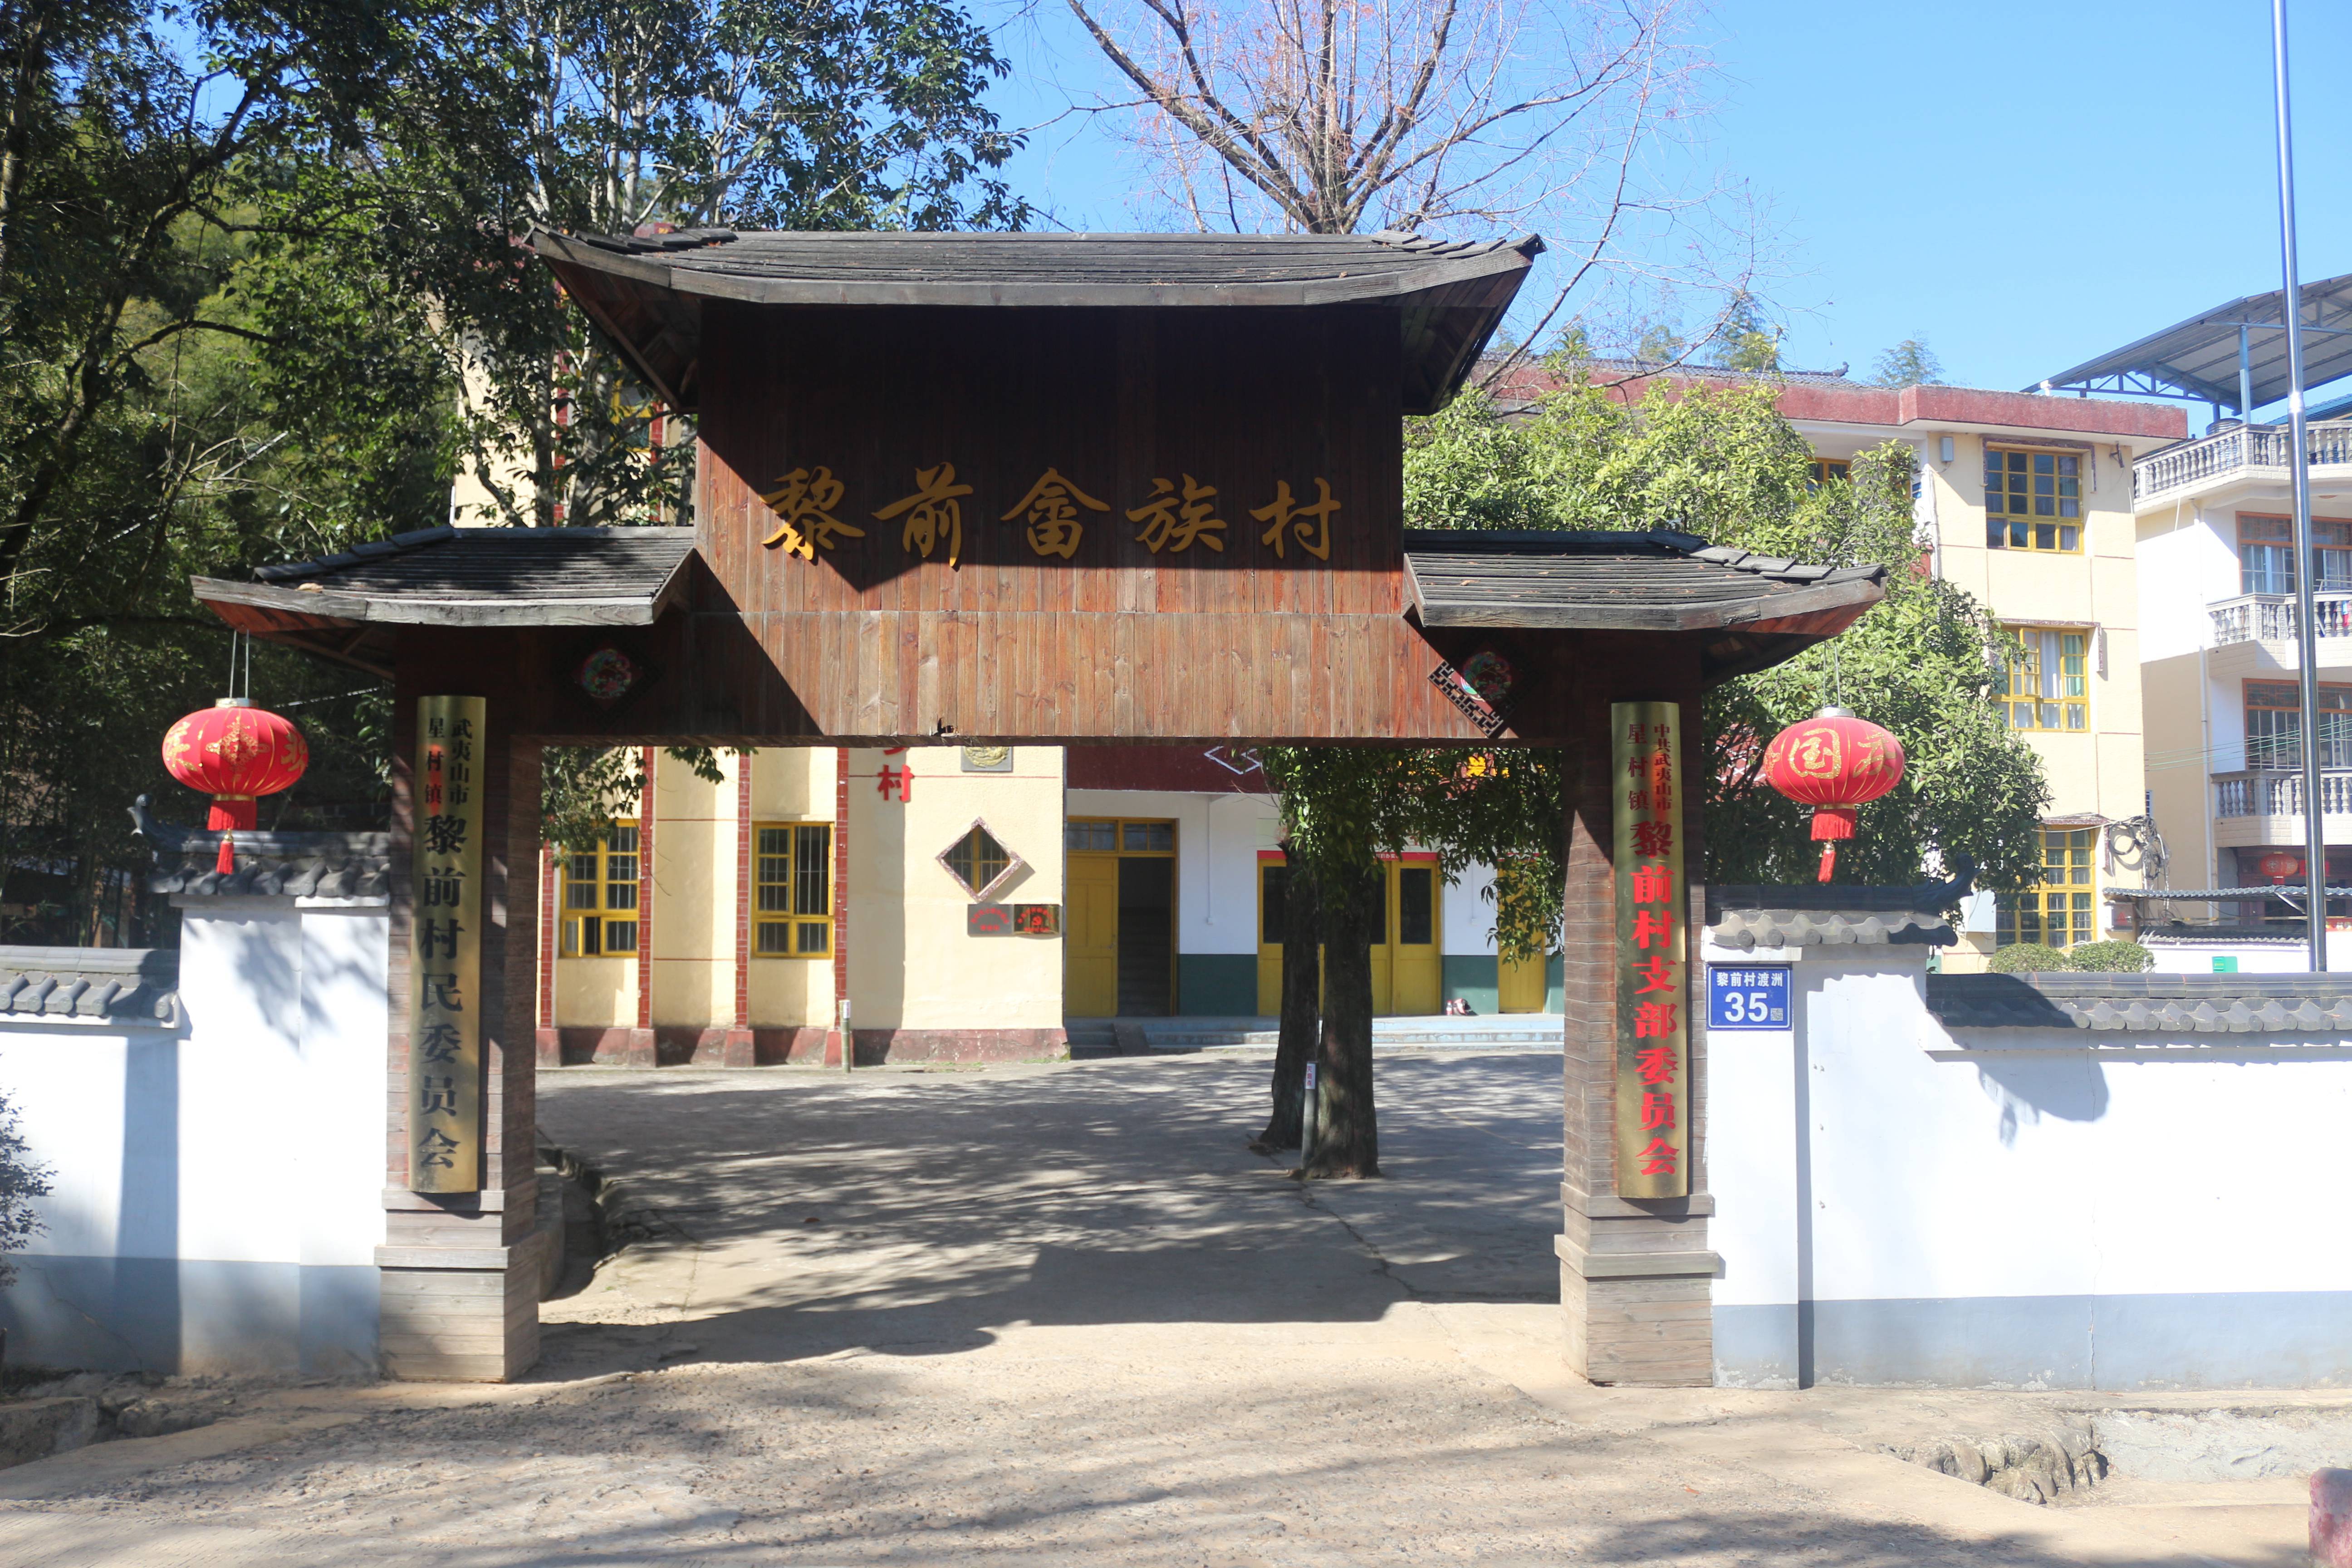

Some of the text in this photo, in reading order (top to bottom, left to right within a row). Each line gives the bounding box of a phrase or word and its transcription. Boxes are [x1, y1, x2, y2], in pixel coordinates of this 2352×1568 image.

[425, 717, 445, 805] 星村镇
[448, 718, 472, 805] 武夷山市
[877, 747, 915, 802] 村
[1627, 723, 1650, 811] 星村镇
[1653, 723, 1672, 811] 中共武夷山市
[417, 814, 467, 1169] 黎前村民委员会
[1629, 820, 1680, 1176] 黎前村支部委员会
[1716, 972, 1783, 987] 黎前村渡洲
[1725, 992, 1768, 1022] 35
